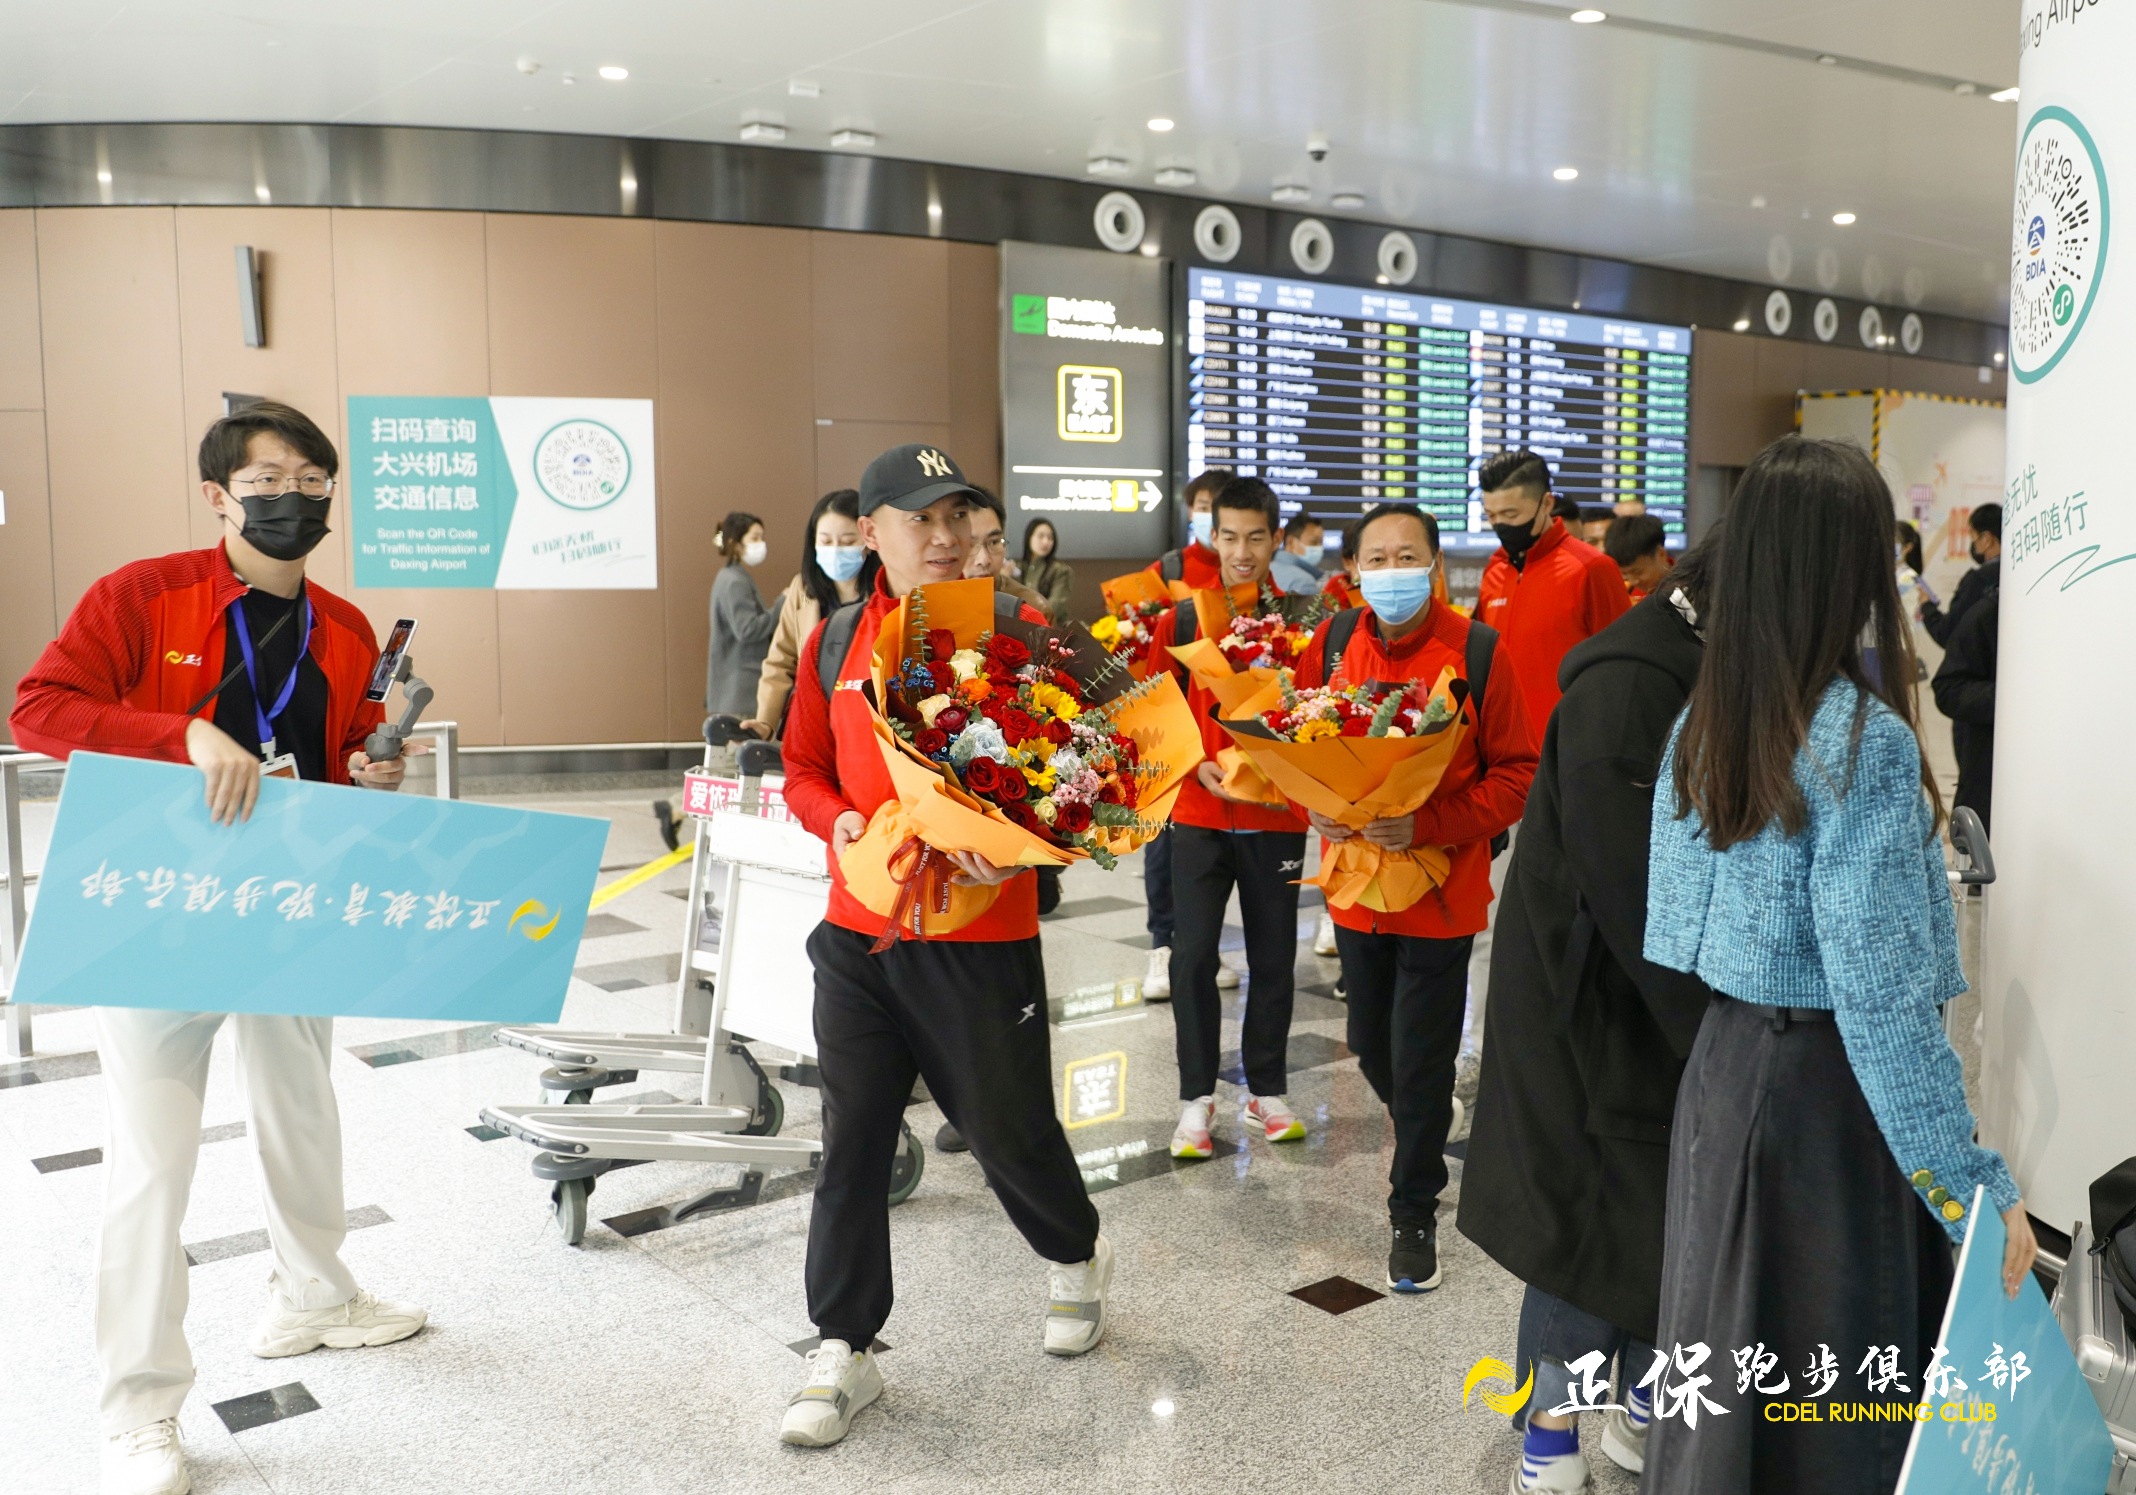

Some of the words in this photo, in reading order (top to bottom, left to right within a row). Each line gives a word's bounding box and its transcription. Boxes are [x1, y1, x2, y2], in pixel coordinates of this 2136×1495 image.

[2025, 258, 2046, 282] BDIA
[1072, 373, 1108, 415] 东
[371, 417, 477, 443] 扫码查询
[1067, 413, 1113, 433] EAST
[372, 450, 479, 477] 大兴机场
[916, 449, 953, 477] NY
[373, 484, 480, 511] 交通信息
[376, 527, 405, 540] Scan
[407, 527, 425, 540] the
[427, 528, 446, 540] QR
[448, 528, 478, 540] Code
[2011, 490, 2089, 571] 扫码随行
[362, 543, 377, 555] for
[380, 543, 415, 555] Traffic
[416, 543, 477, 555] Information
[480, 543, 490, 555] of
[390, 557, 428, 572] Daxing
[430, 557, 467, 571] Airport
